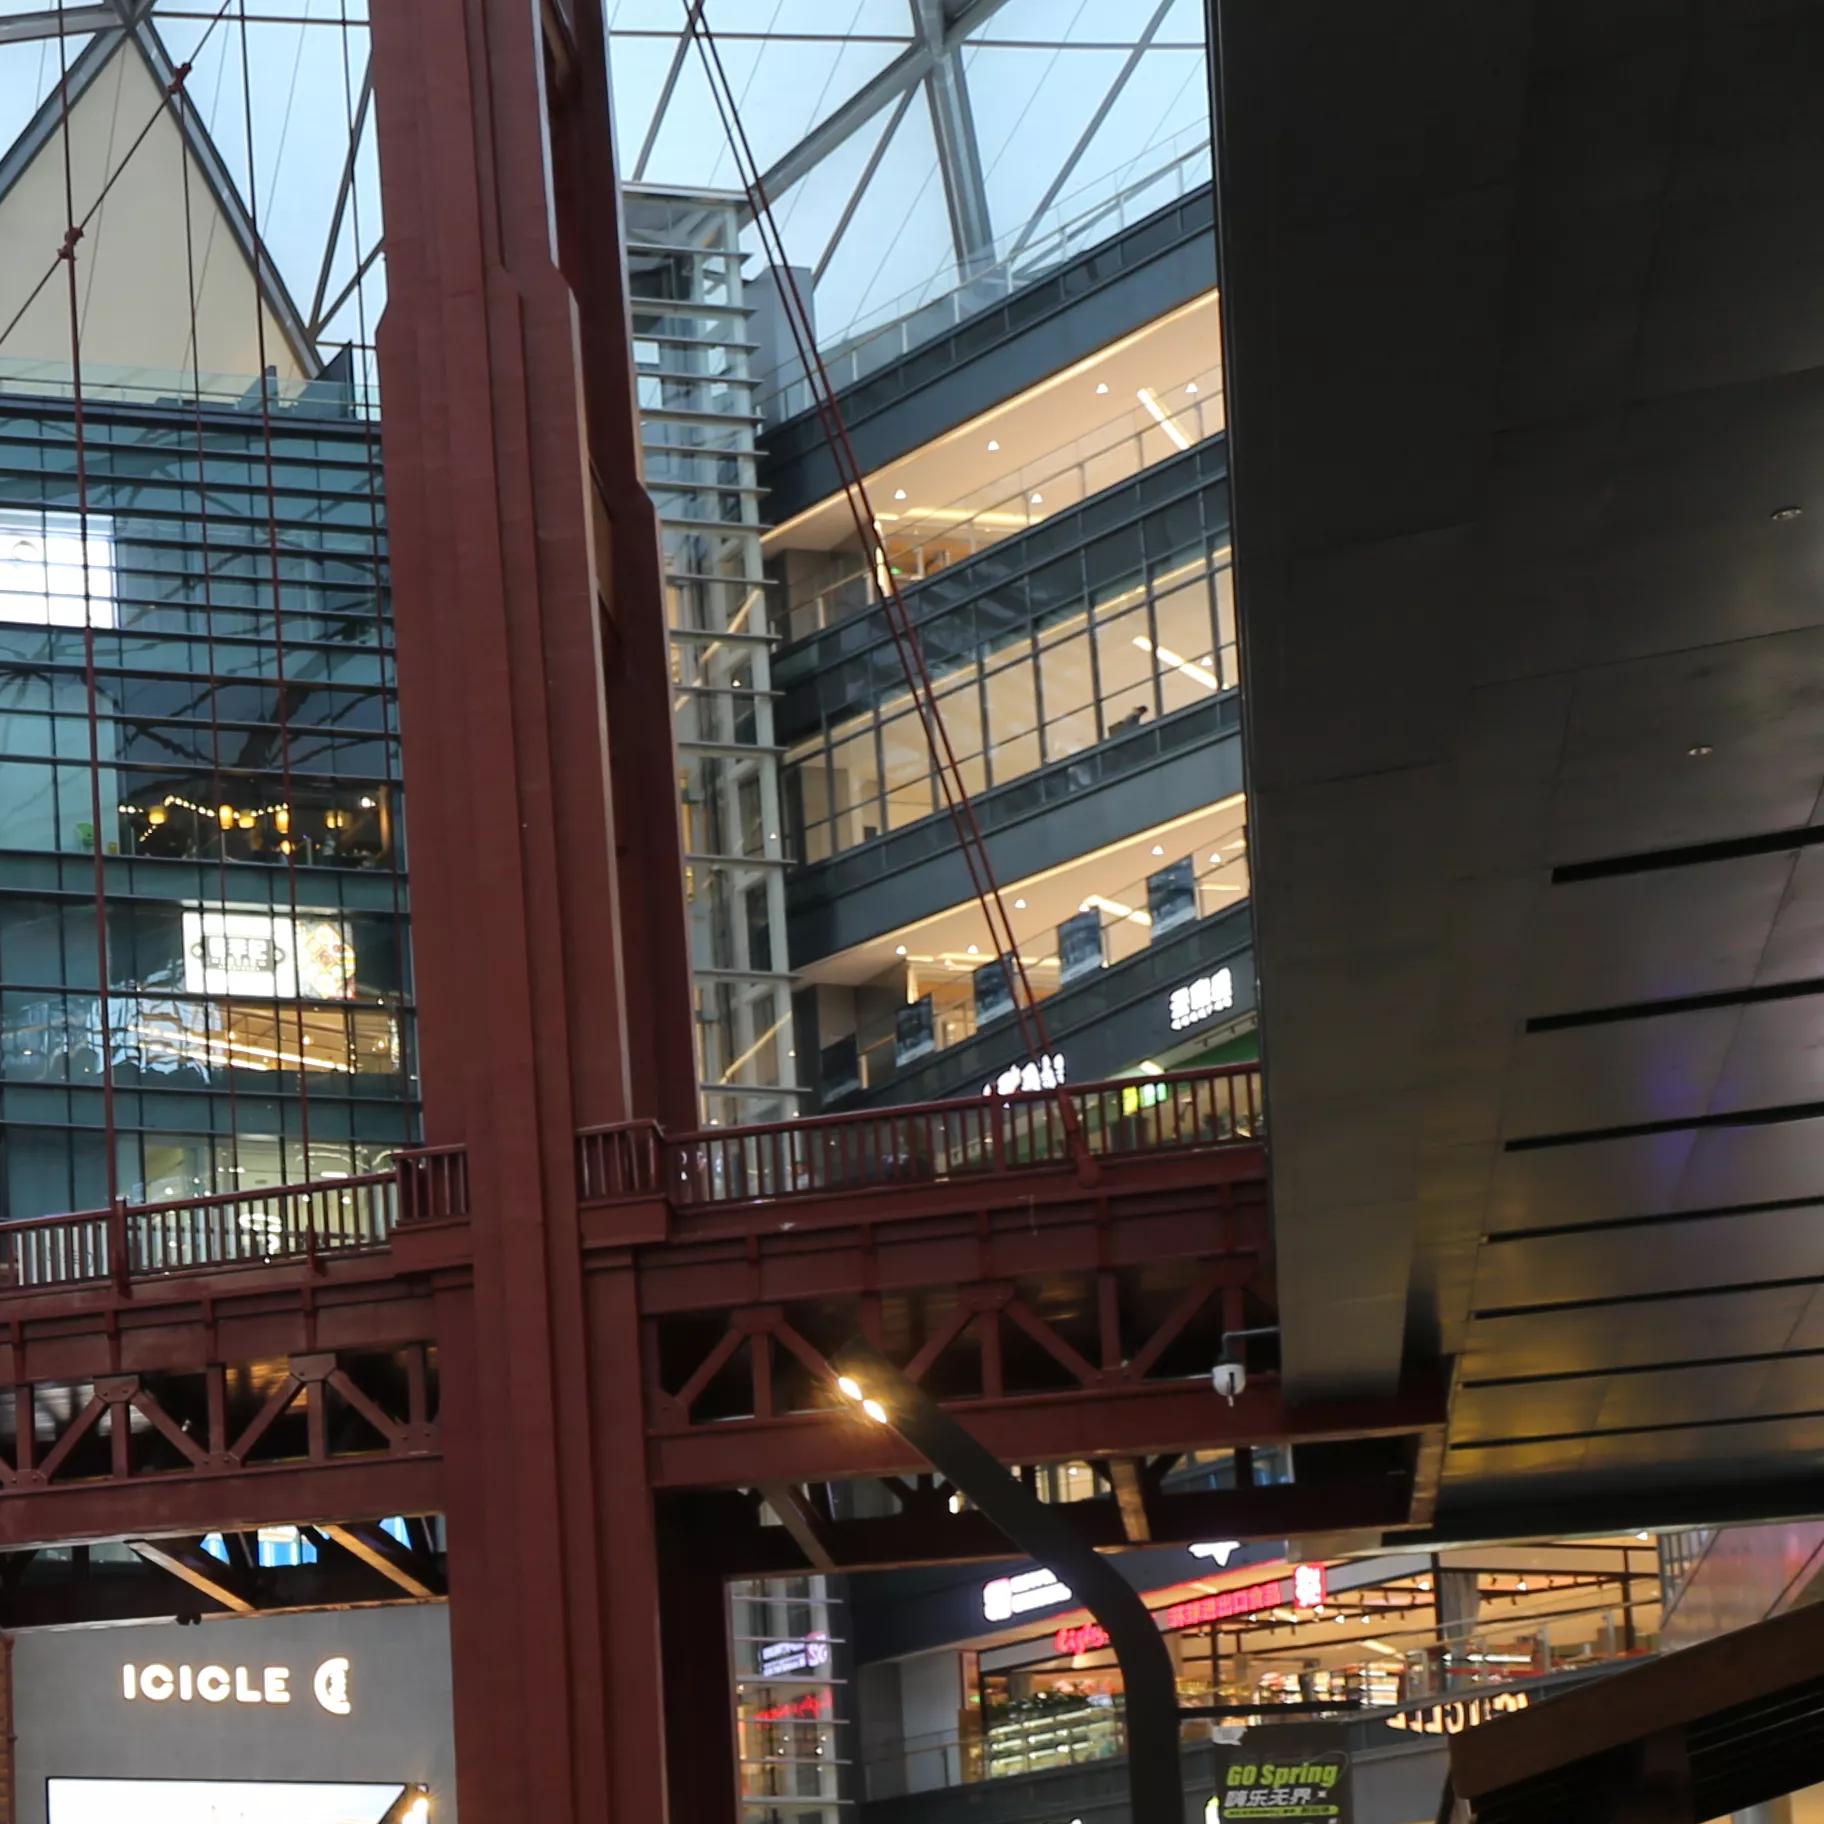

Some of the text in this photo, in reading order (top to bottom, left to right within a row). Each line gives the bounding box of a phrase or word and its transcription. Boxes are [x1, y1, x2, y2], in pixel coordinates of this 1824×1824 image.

[122, 1663, 241, 1703] ICICLE
[1227, 1761, 1339, 1789] GO Spring
